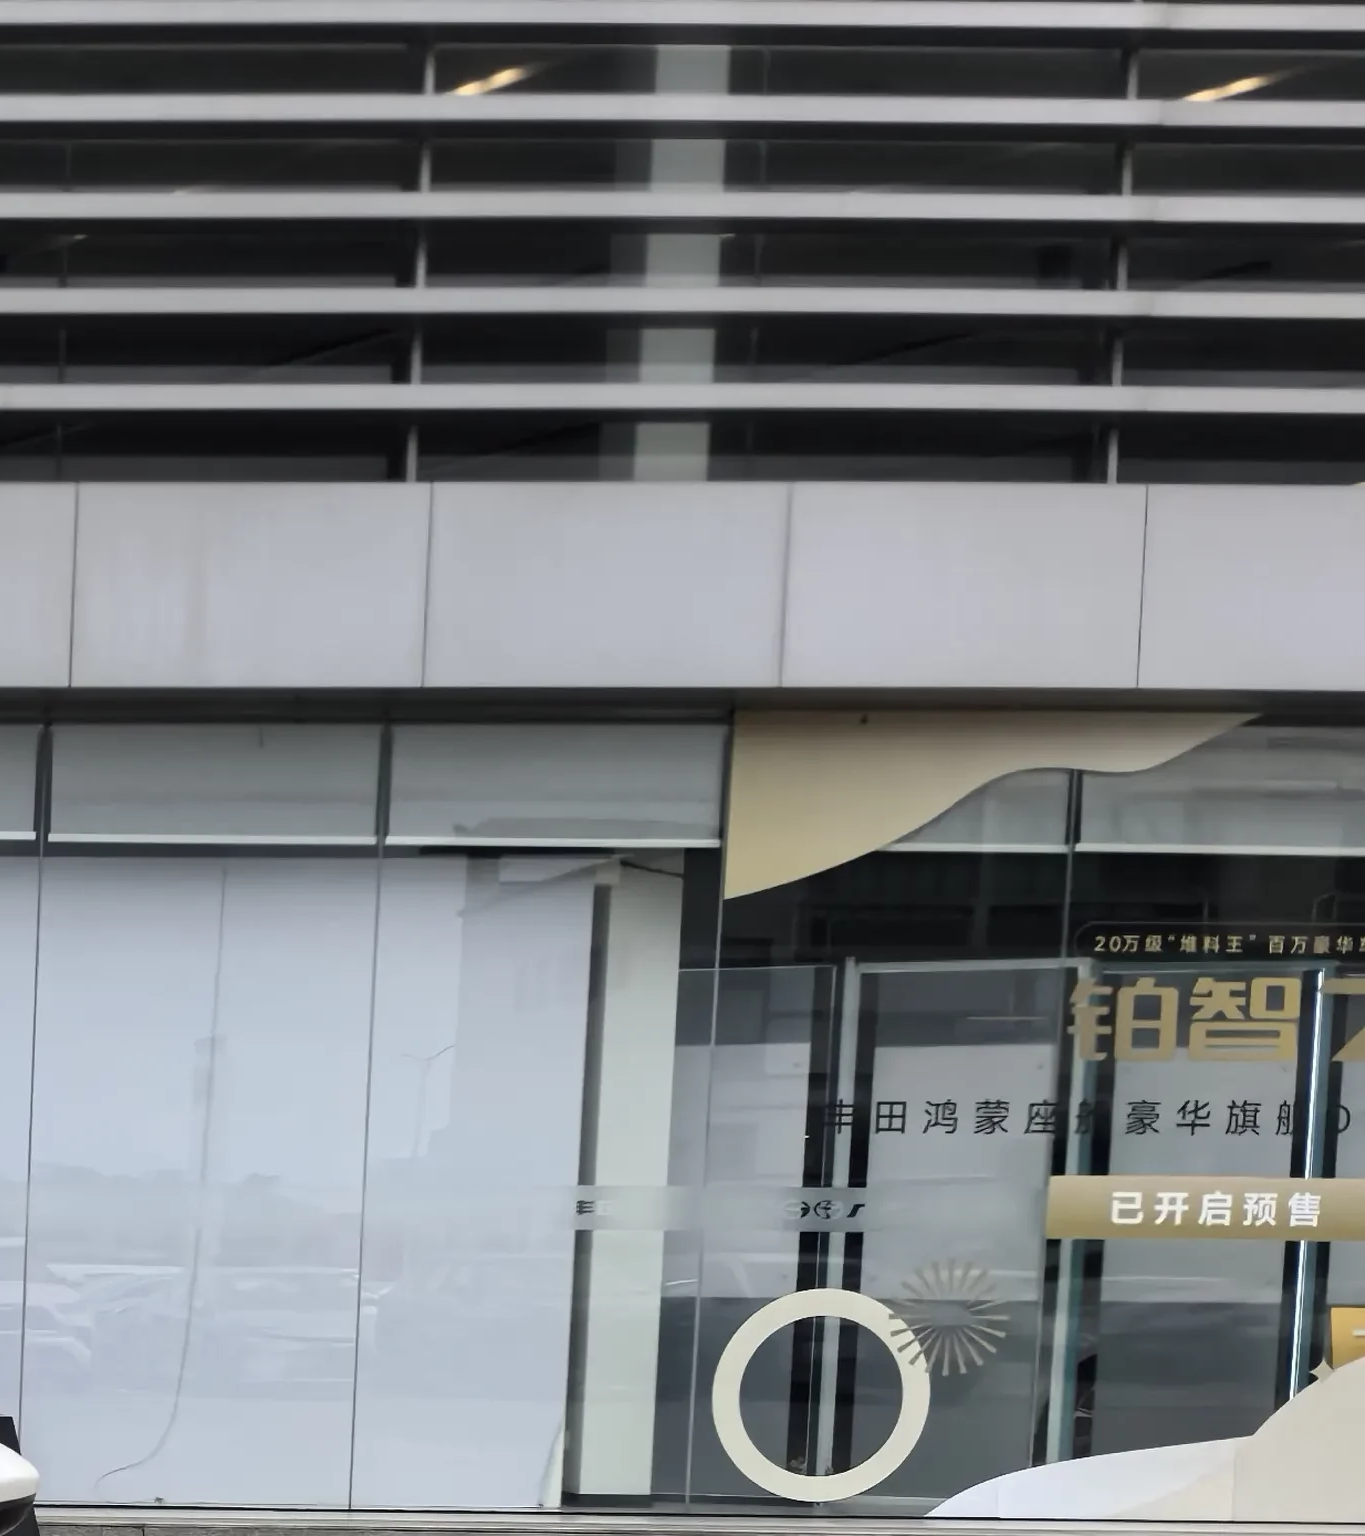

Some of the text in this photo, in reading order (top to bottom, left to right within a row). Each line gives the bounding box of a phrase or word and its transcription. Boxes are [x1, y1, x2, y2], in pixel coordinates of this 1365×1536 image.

[1109, 1191, 1322, 1227] 已开启预售
